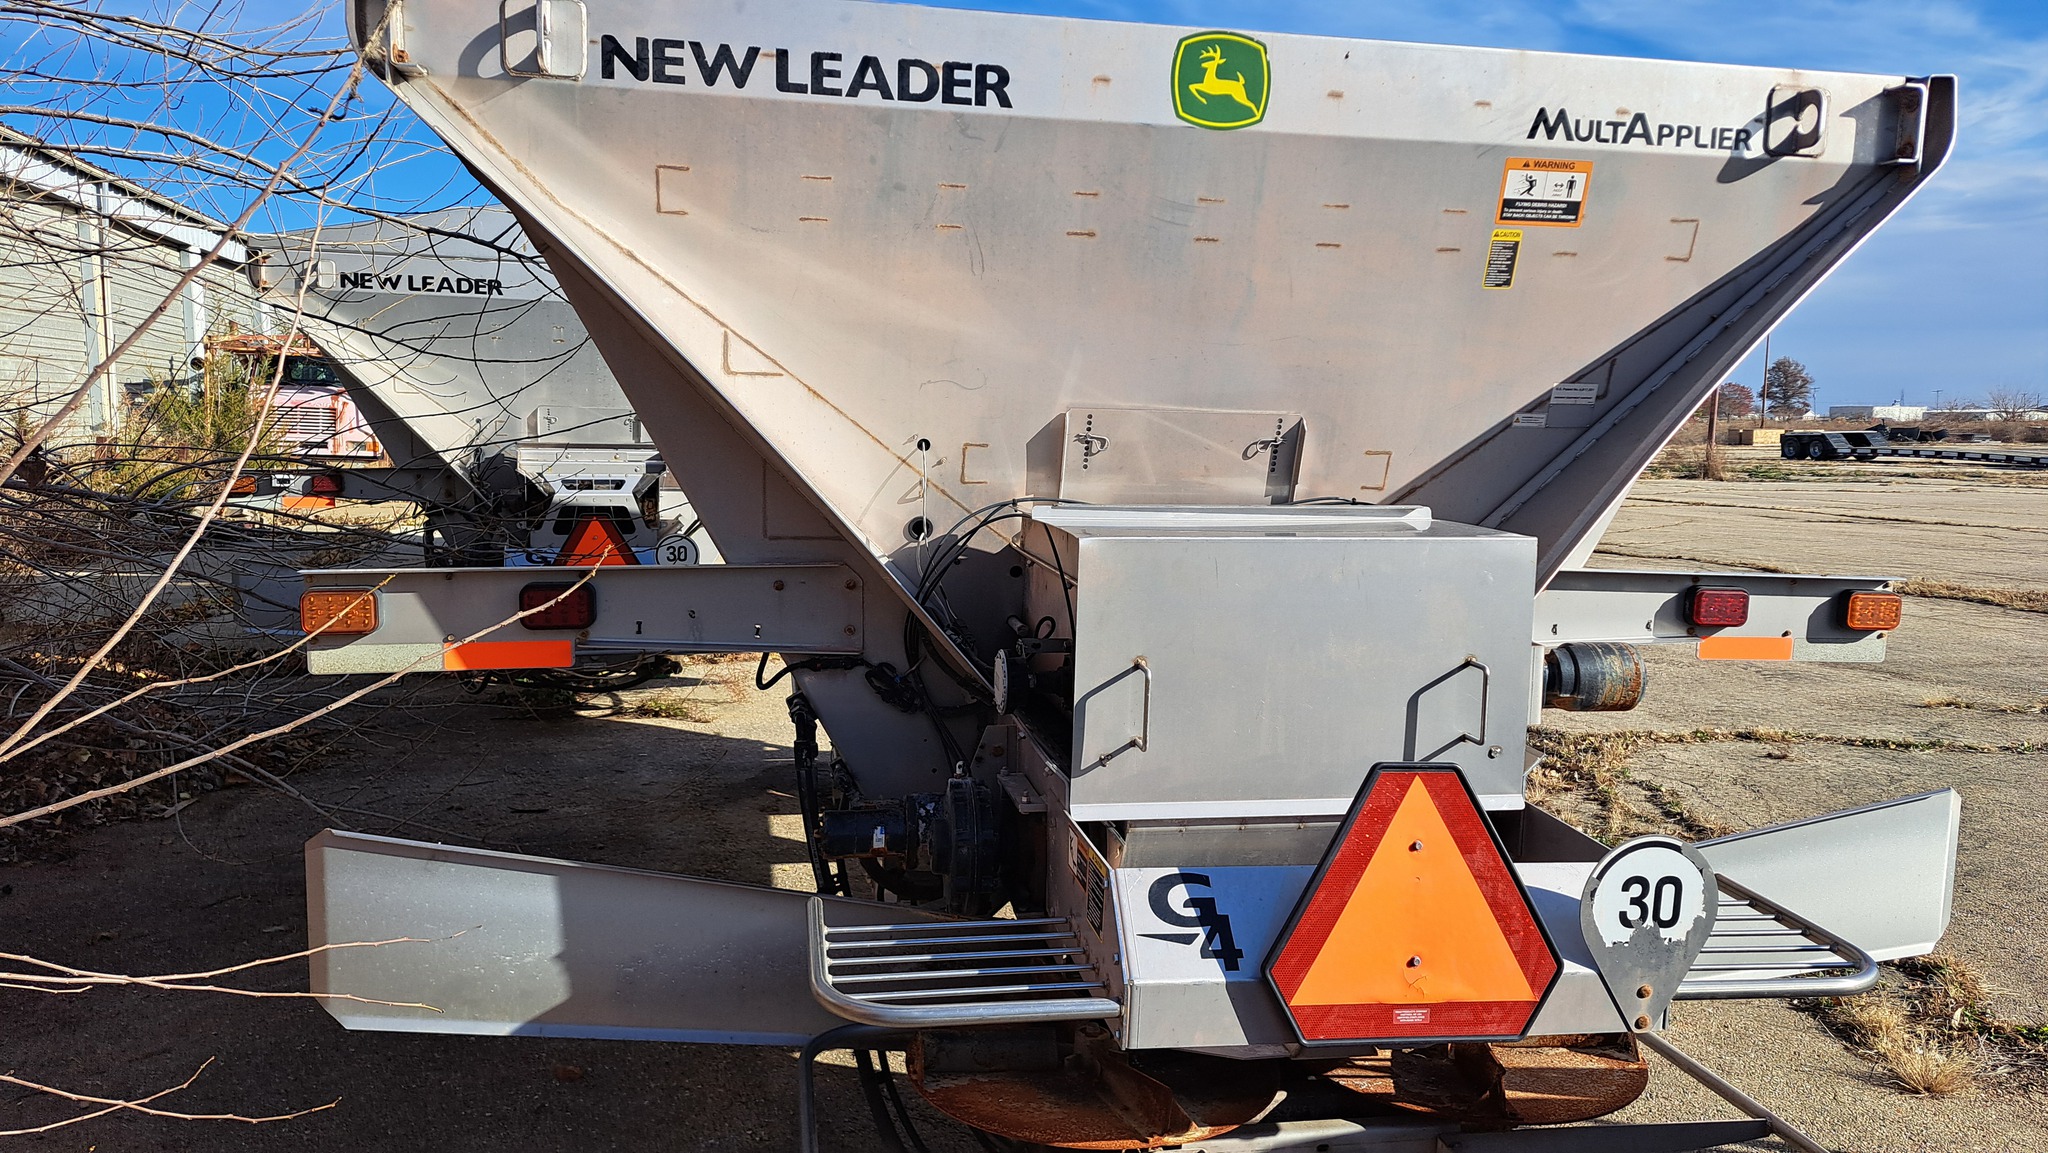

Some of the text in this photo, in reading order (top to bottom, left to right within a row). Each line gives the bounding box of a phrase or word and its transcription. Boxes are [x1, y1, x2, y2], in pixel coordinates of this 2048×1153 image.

[601, 34, 1013, 108] NEW LEADER
[1534, 160, 1575, 170] WARNING
[340, 272, 503, 296] NEW LEADER
[666, 546, 688, 562] 30
[1148, 872, 1244, 972] G4
[1618, 875, 1683, 930] 30
